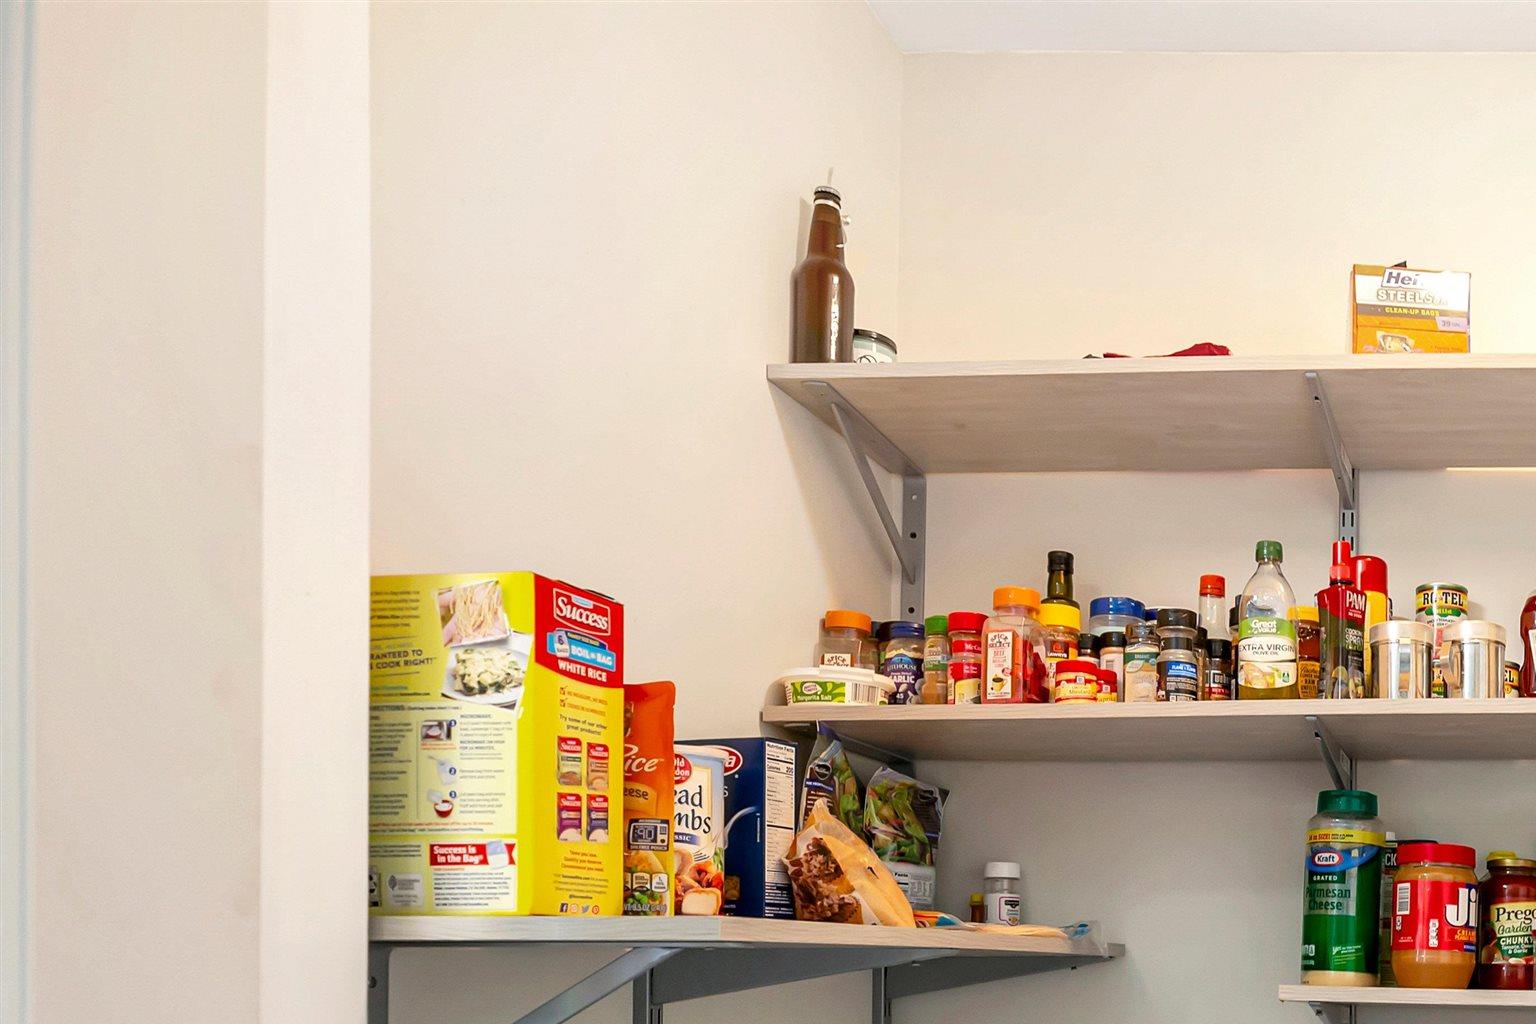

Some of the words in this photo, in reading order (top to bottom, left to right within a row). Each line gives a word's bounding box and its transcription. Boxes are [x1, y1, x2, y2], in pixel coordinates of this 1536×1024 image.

[1385, 307, 1420, 316] CLEAN-UP
[1421, 309, 1440, 317] BAGS
[1346, 590, 1366, 611] PAM
[556, 596, 608, 630] Success
[411, 649, 423, 657] TO
[1238, 643, 1265, 652] EXTRA
[1267, 643, 1296, 653] VIRGIN
[570, 645, 589, 659] BOIL
[596, 653, 613, 666] BAG
[558, 659, 587, 677] WHITE
[587, 667, 608, 683] RICE
[433, 845, 467, 855] Success
[468, 845, 476, 854] is
[437, 855, 446, 863] in
[447, 854, 461, 863] the
[1317, 854, 1335, 863] Kraft
[1305, 886, 1351, 899] Parmesan
[1308, 900, 1343, 911] Cheese
[1445, 887, 1478, 928] Ji
[1498, 921, 1533, 936] Garden
[1500, 936, 1534, 945] CHUNKY
